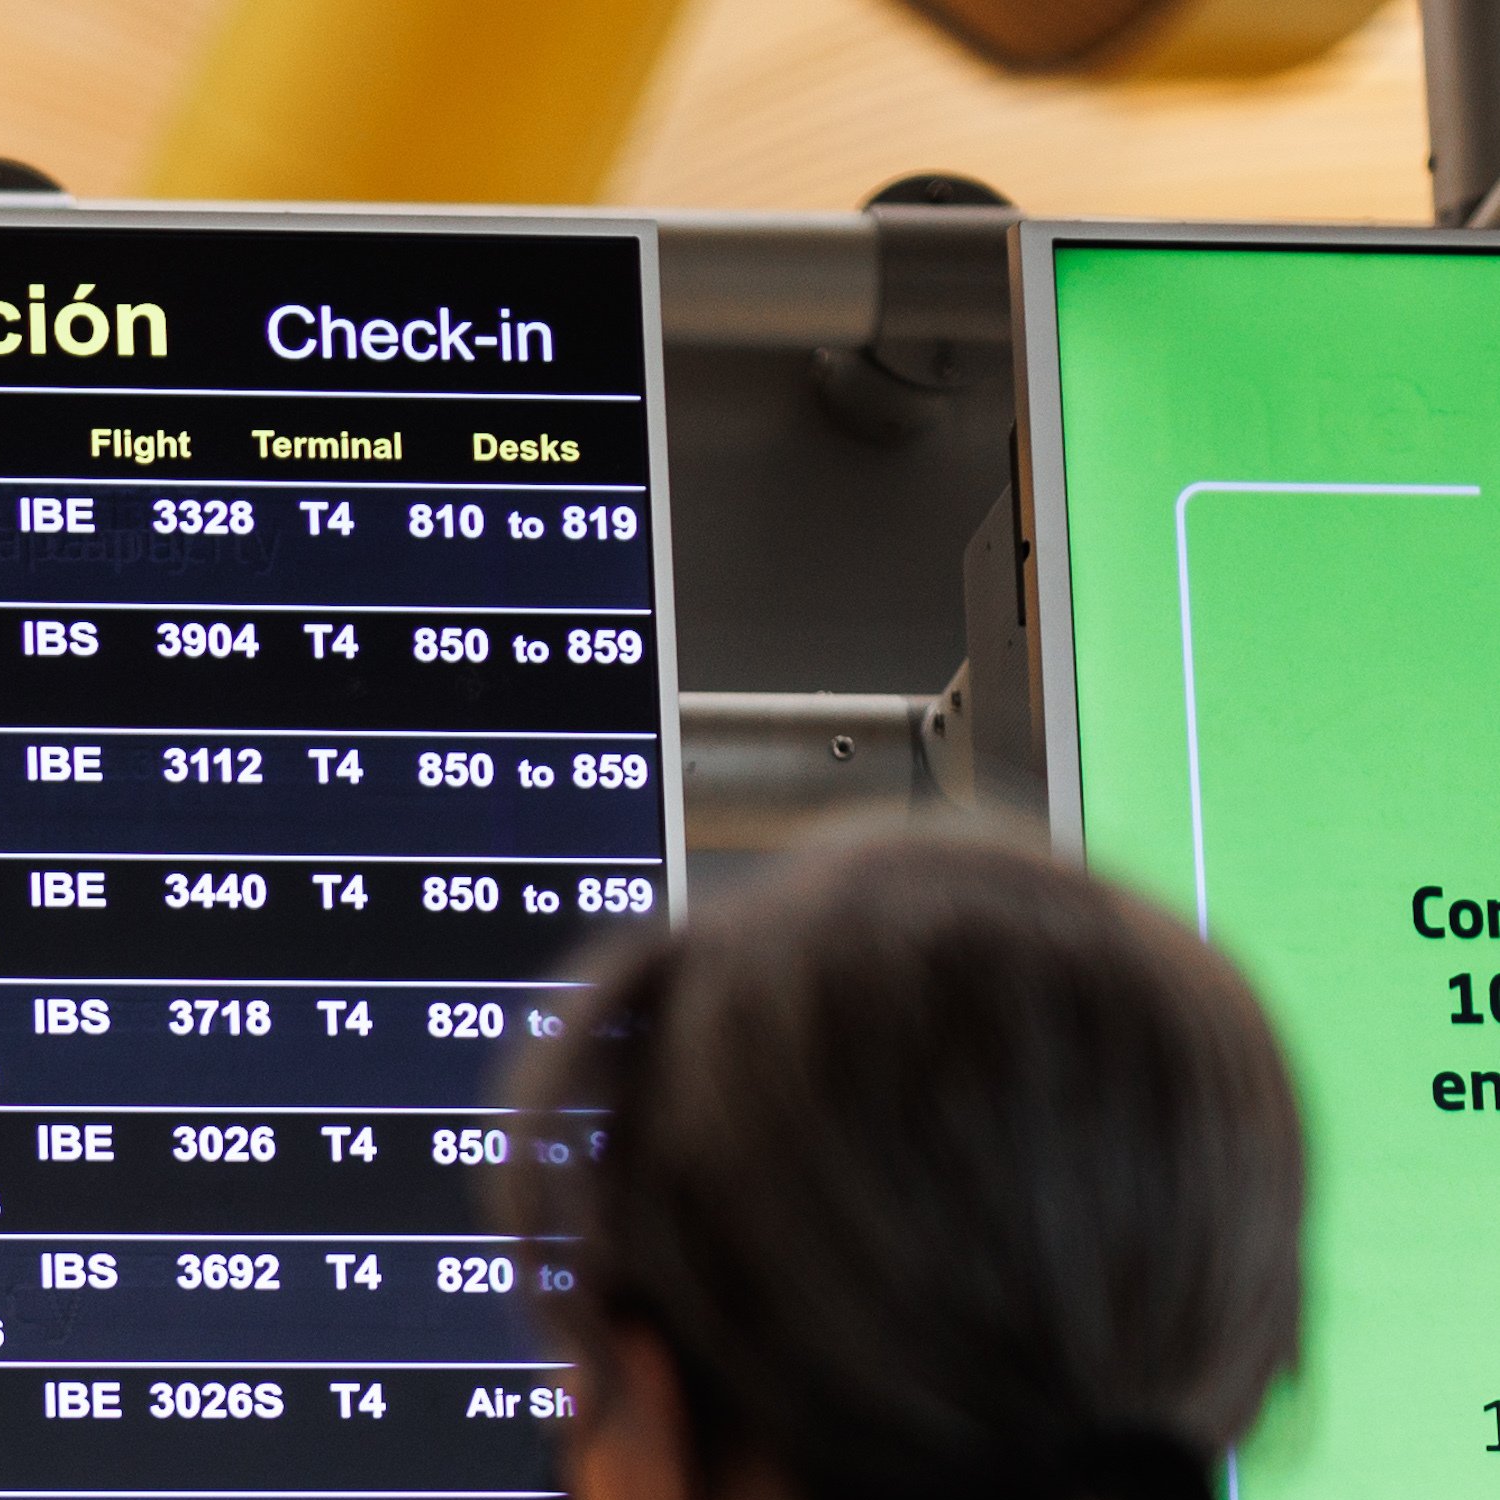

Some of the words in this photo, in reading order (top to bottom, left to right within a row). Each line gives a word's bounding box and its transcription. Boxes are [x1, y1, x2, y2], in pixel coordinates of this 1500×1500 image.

[267, 304, 553, 363] Check-in
[91, 428, 192, 465] Flight
[251, 429, 403, 460] Terminal
[473, 432, 581, 462] Desks
[20, 497, 96, 534] IBE
[152, 499, 255, 535] 3328
[299, 501, 355, 536] T4
[409, 503, 485, 539] 810
[507, 510, 545, 539] to
[562, 505, 637, 541] 819
[23, 620, 99, 656] IBS
[157, 622, 260, 659] 3904
[303, 623, 360, 660] T4
[413, 627, 489, 663] 850
[512, 634, 550, 664] to
[567, 629, 643, 665] 859
[26, 746, 104, 782] IBE
[163, 747, 263, 784] 3112
[307, 748, 364, 785] T4
[418, 751, 494, 788] 850
[517, 758, 555, 788] to
[572, 753, 648, 790] 859
[30, 871, 107, 908] IBE
[164, 873, 267, 909] 3440
[312, 874, 369, 910] T4
[423, 876, 499, 912] 850
[522, 884, 560, 914] to
[577, 877, 654, 914] 859
[34, 998, 111, 1035] IBS
[168, 999, 272, 1036] 3718
[316, 1000, 373, 1037] T4
[427, 1002, 504, 1038] 820
[37, 1124, 115, 1161] IBE
[172, 1125, 276, 1162] 3026
[320, 1126, 378, 1163] T4
[432, 1129, 507, 1165] 850
[41, 1252, 118, 1290] IBS
[176, 1253, 281, 1290] 3692
[325, 1254, 382, 1290] T4
[437, 1257, 514, 1293] 820
[44, 1381, 123, 1419] IBE
[149, 1382, 285, 1419] 3026S
[329, 1383, 387, 1419] T4
[466, 1387, 522, 1418] Air
